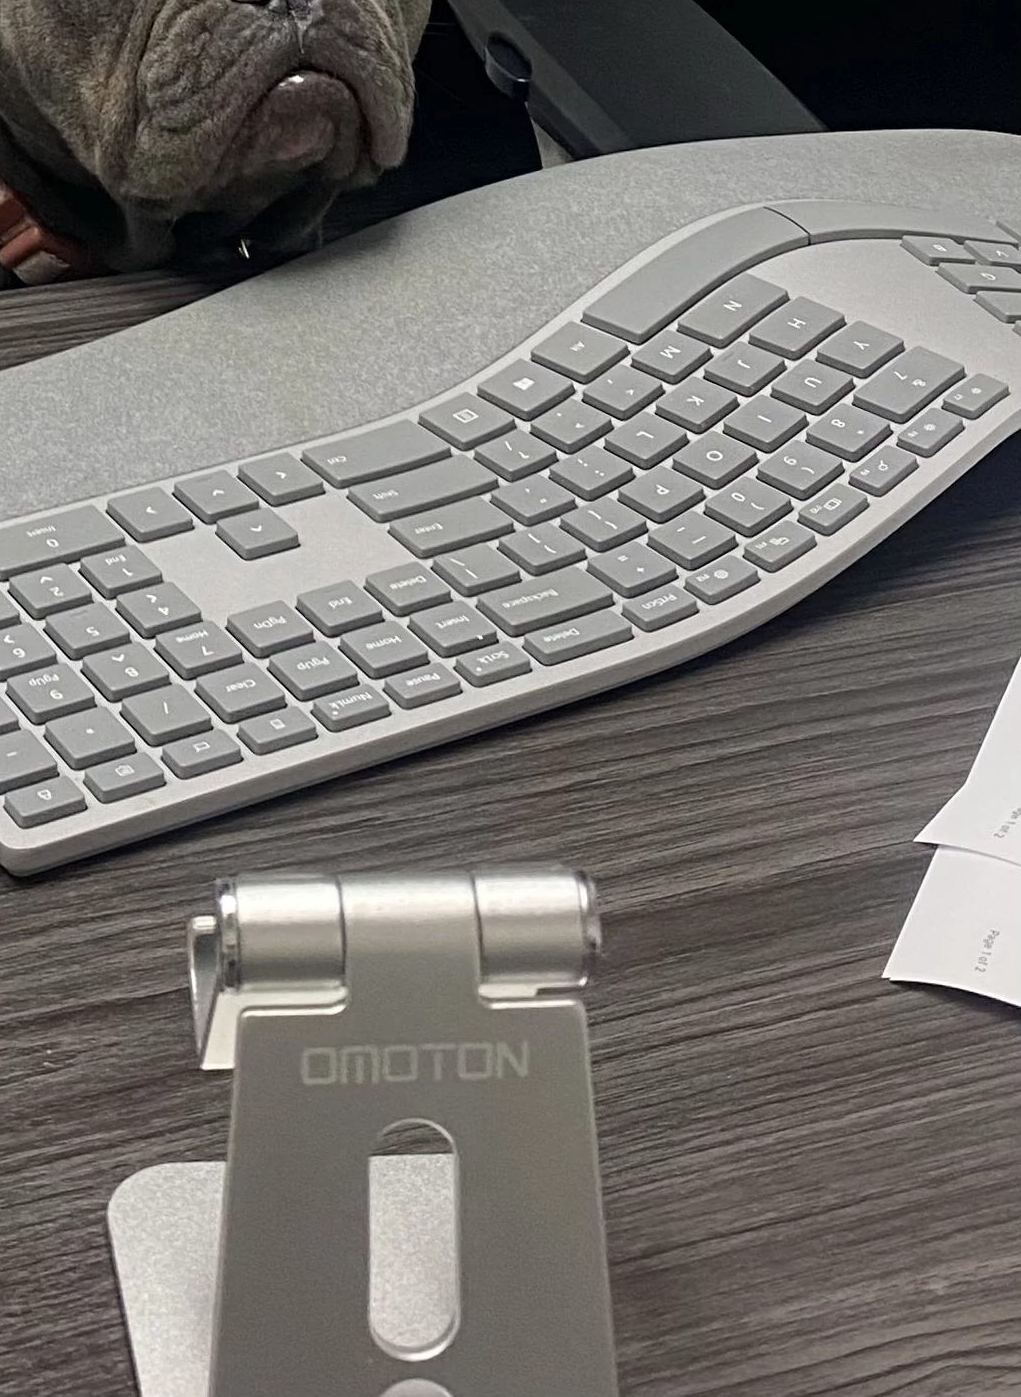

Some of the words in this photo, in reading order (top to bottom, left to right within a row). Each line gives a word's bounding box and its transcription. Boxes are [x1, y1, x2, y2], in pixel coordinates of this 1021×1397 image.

[723, 300, 742, 311] N
[787, 318, 806, 328] H
[853, 341, 870, 350] Y
[660, 346, 681, 358] M
[737, 359, 750, 368] J
[894, 371, 907, 380] 7
[804, 377, 822, 388] U
[686, 395, 704, 406] K
[831, 419, 845, 427] 8
[636, 431, 654, 439] L
[784, 456, 797, 465] 9
[656, 484, 670, 495] P
[390, 576, 427, 589] Delete
[49, 587, 64, 596] 2
[328, 597, 352, 609] End
[501, 589, 559, 609] Backspace
[641, 594, 677, 610] PrtScn
[158, 607, 169, 615] 4
[254, 616, 287, 629] PgDn
[435, 615, 470, 629] Insert
[86, 627, 99, 636] 5
[175, 630, 209, 643] Home
[540, 627, 580, 642] Delete
[366, 636, 402, 649] Home
[13, 648, 26, 658] 6
[202, 646, 214, 656] 7
[475, 648, 512, 665] ScrLk
[297, 656, 330, 671] PgUp
[125, 667, 139, 677] 8
[28, 673, 59, 687] PgUp
[405, 671, 440, 686] Pause
[226, 679, 256, 692] Clear
[50, 690, 63, 699] 9
[329, 689, 373, 709] NumLk
[299, 1041, 529, 1087] OMOTON
